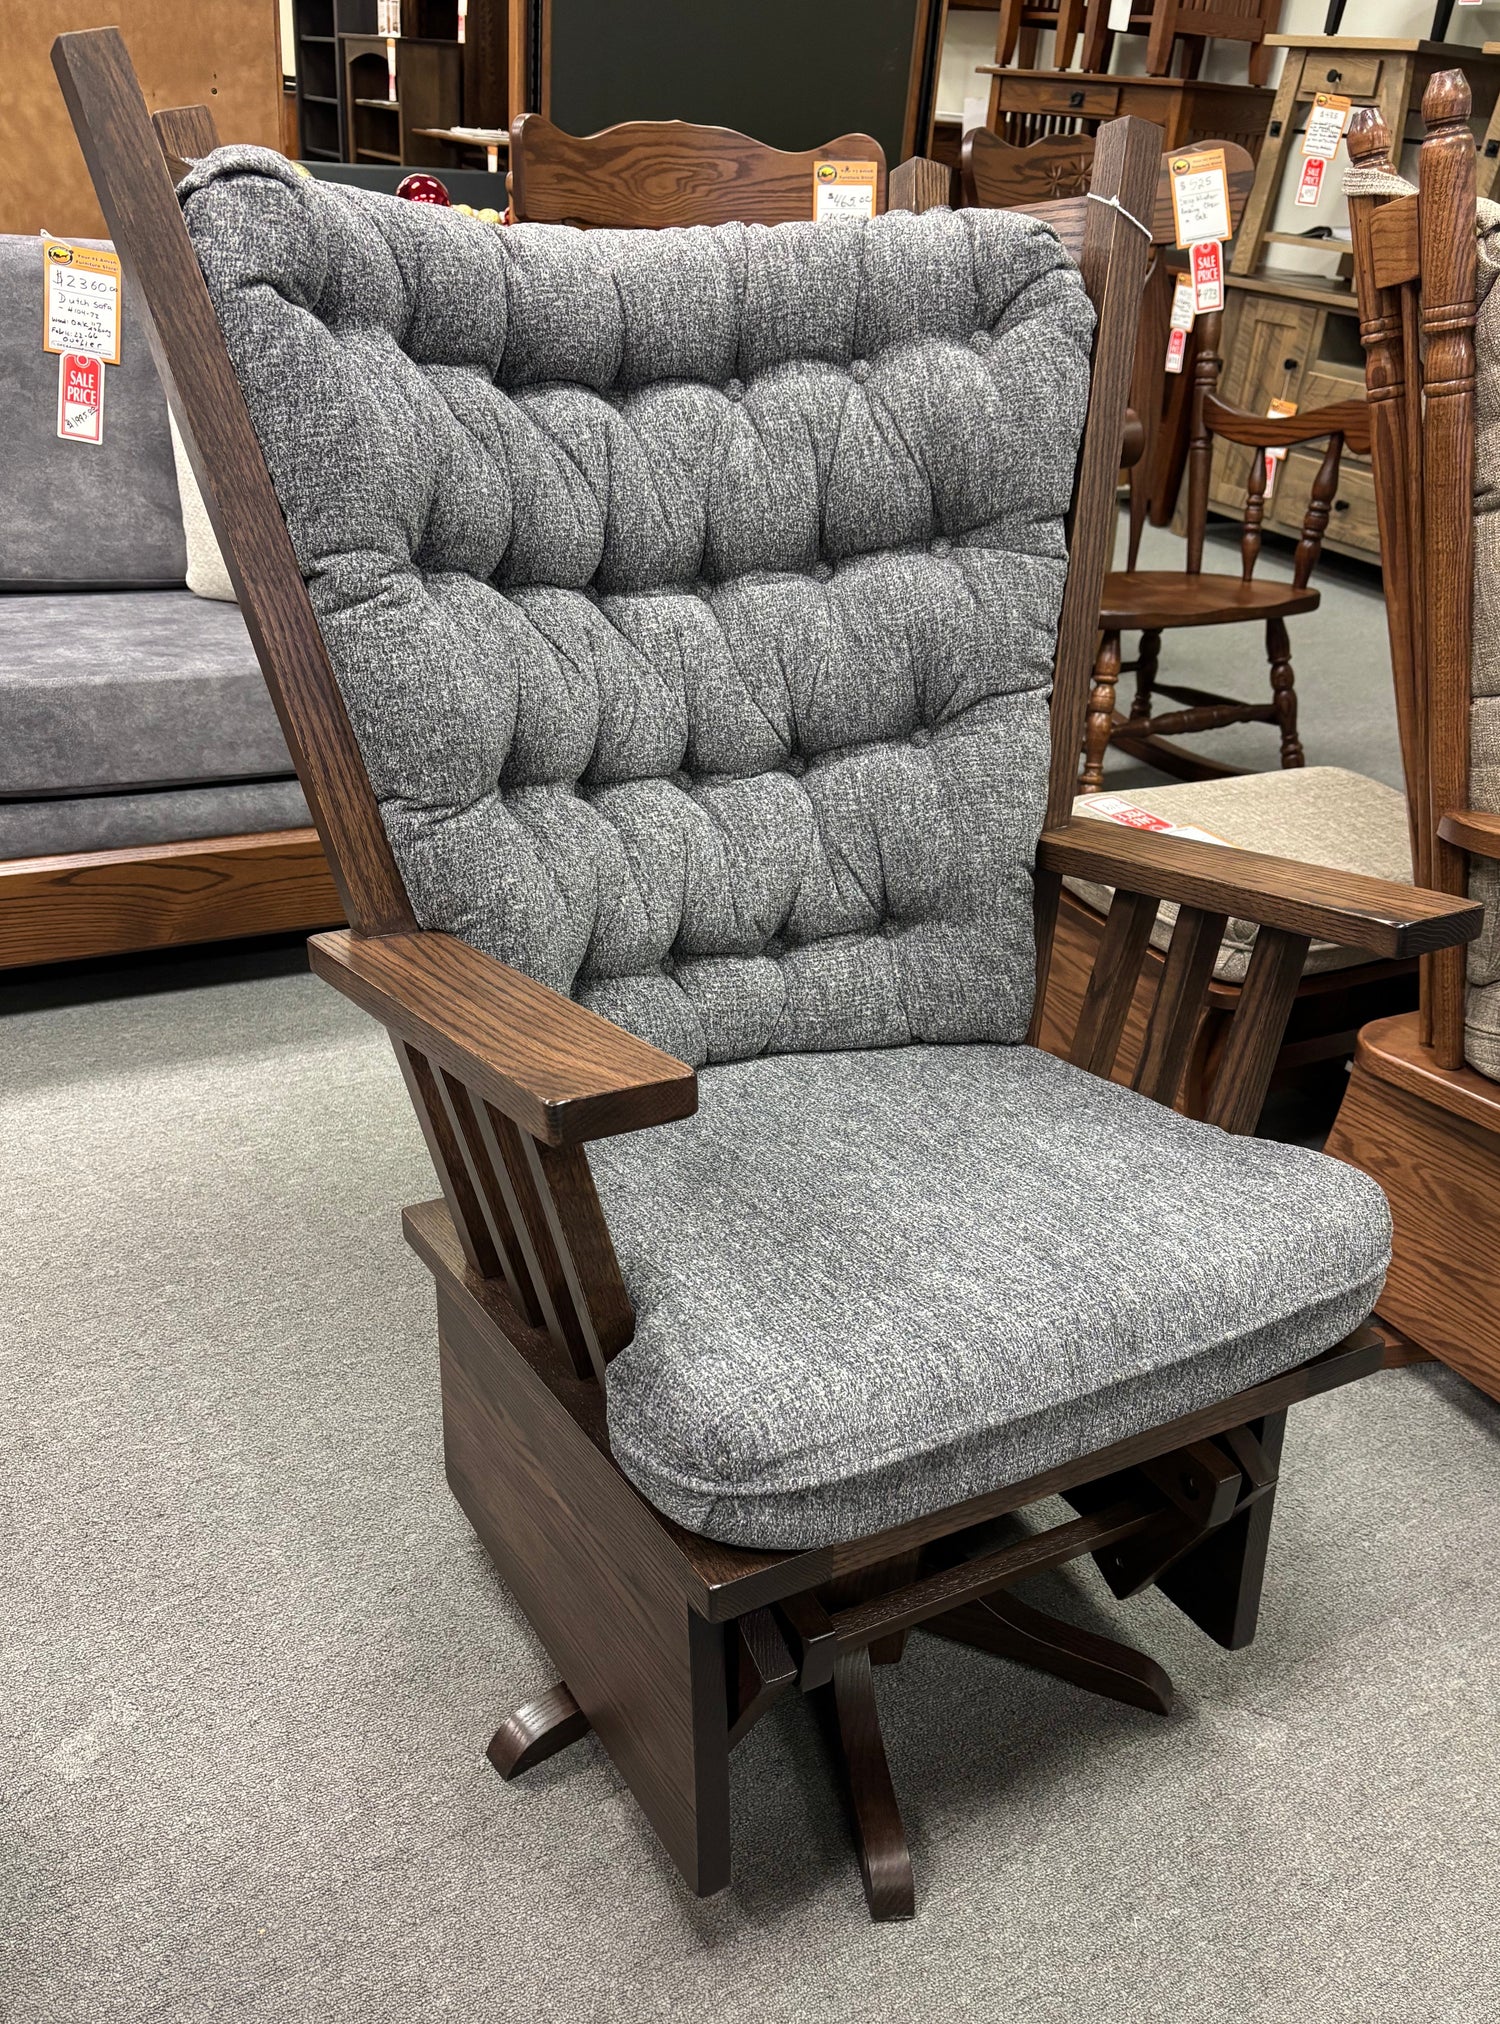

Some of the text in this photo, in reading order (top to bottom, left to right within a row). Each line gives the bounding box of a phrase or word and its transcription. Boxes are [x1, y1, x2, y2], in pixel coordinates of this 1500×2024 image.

[1306, 166, 1321, 177] SALE
[1303, 175, 1320, 186] PRICE
[75, 260, 101, 268] Furniture
[1197, 254, 1217, 270] SALE
[1197, 267, 1219, 282] PRICE
[58, 291, 90, 306] Dutch
[69, 369, 95, 389] SALE
[67, 385, 97, 405] PRICE
